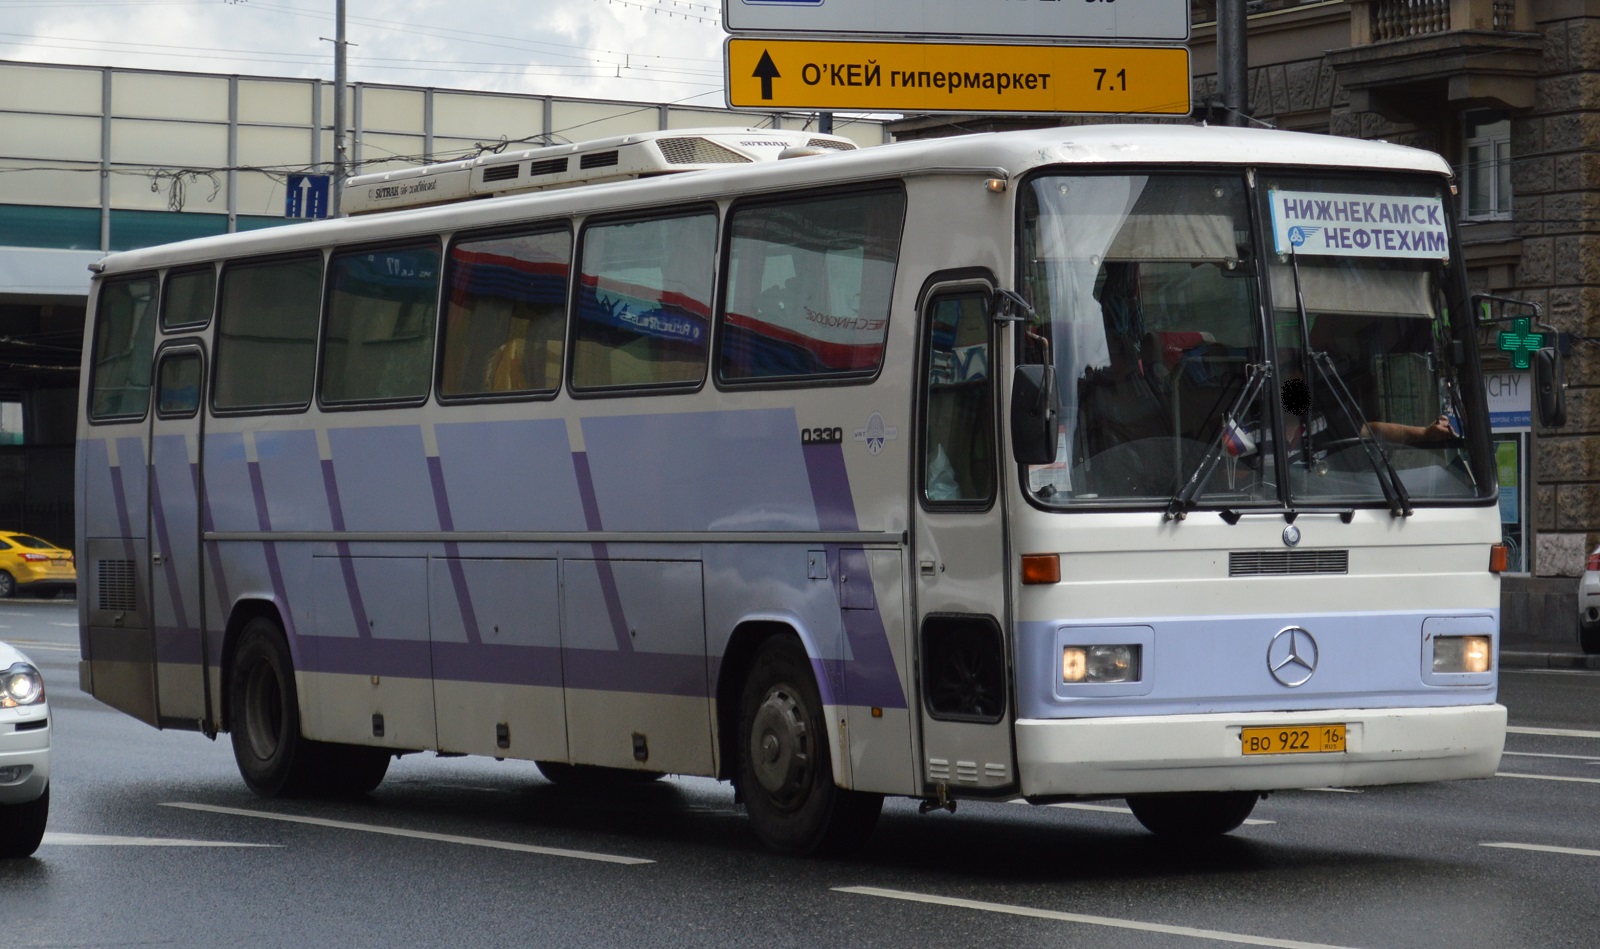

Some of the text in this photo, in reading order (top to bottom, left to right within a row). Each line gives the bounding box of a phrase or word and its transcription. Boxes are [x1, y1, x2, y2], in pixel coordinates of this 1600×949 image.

[802, 59, 1128, 95] О’КЕЙ гипермаркет 7.1
[375, 185, 399, 199] SUTRAK
[1283, 198, 1442, 226] НИЖНЕКАМСК
[1324, 227, 1446, 252] НЕФТЕХИМ
[1485, 374, 1521, 397] ICHY
[1279, 730, 1310, 750] 922
[1324, 729, 1339, 743] 16
